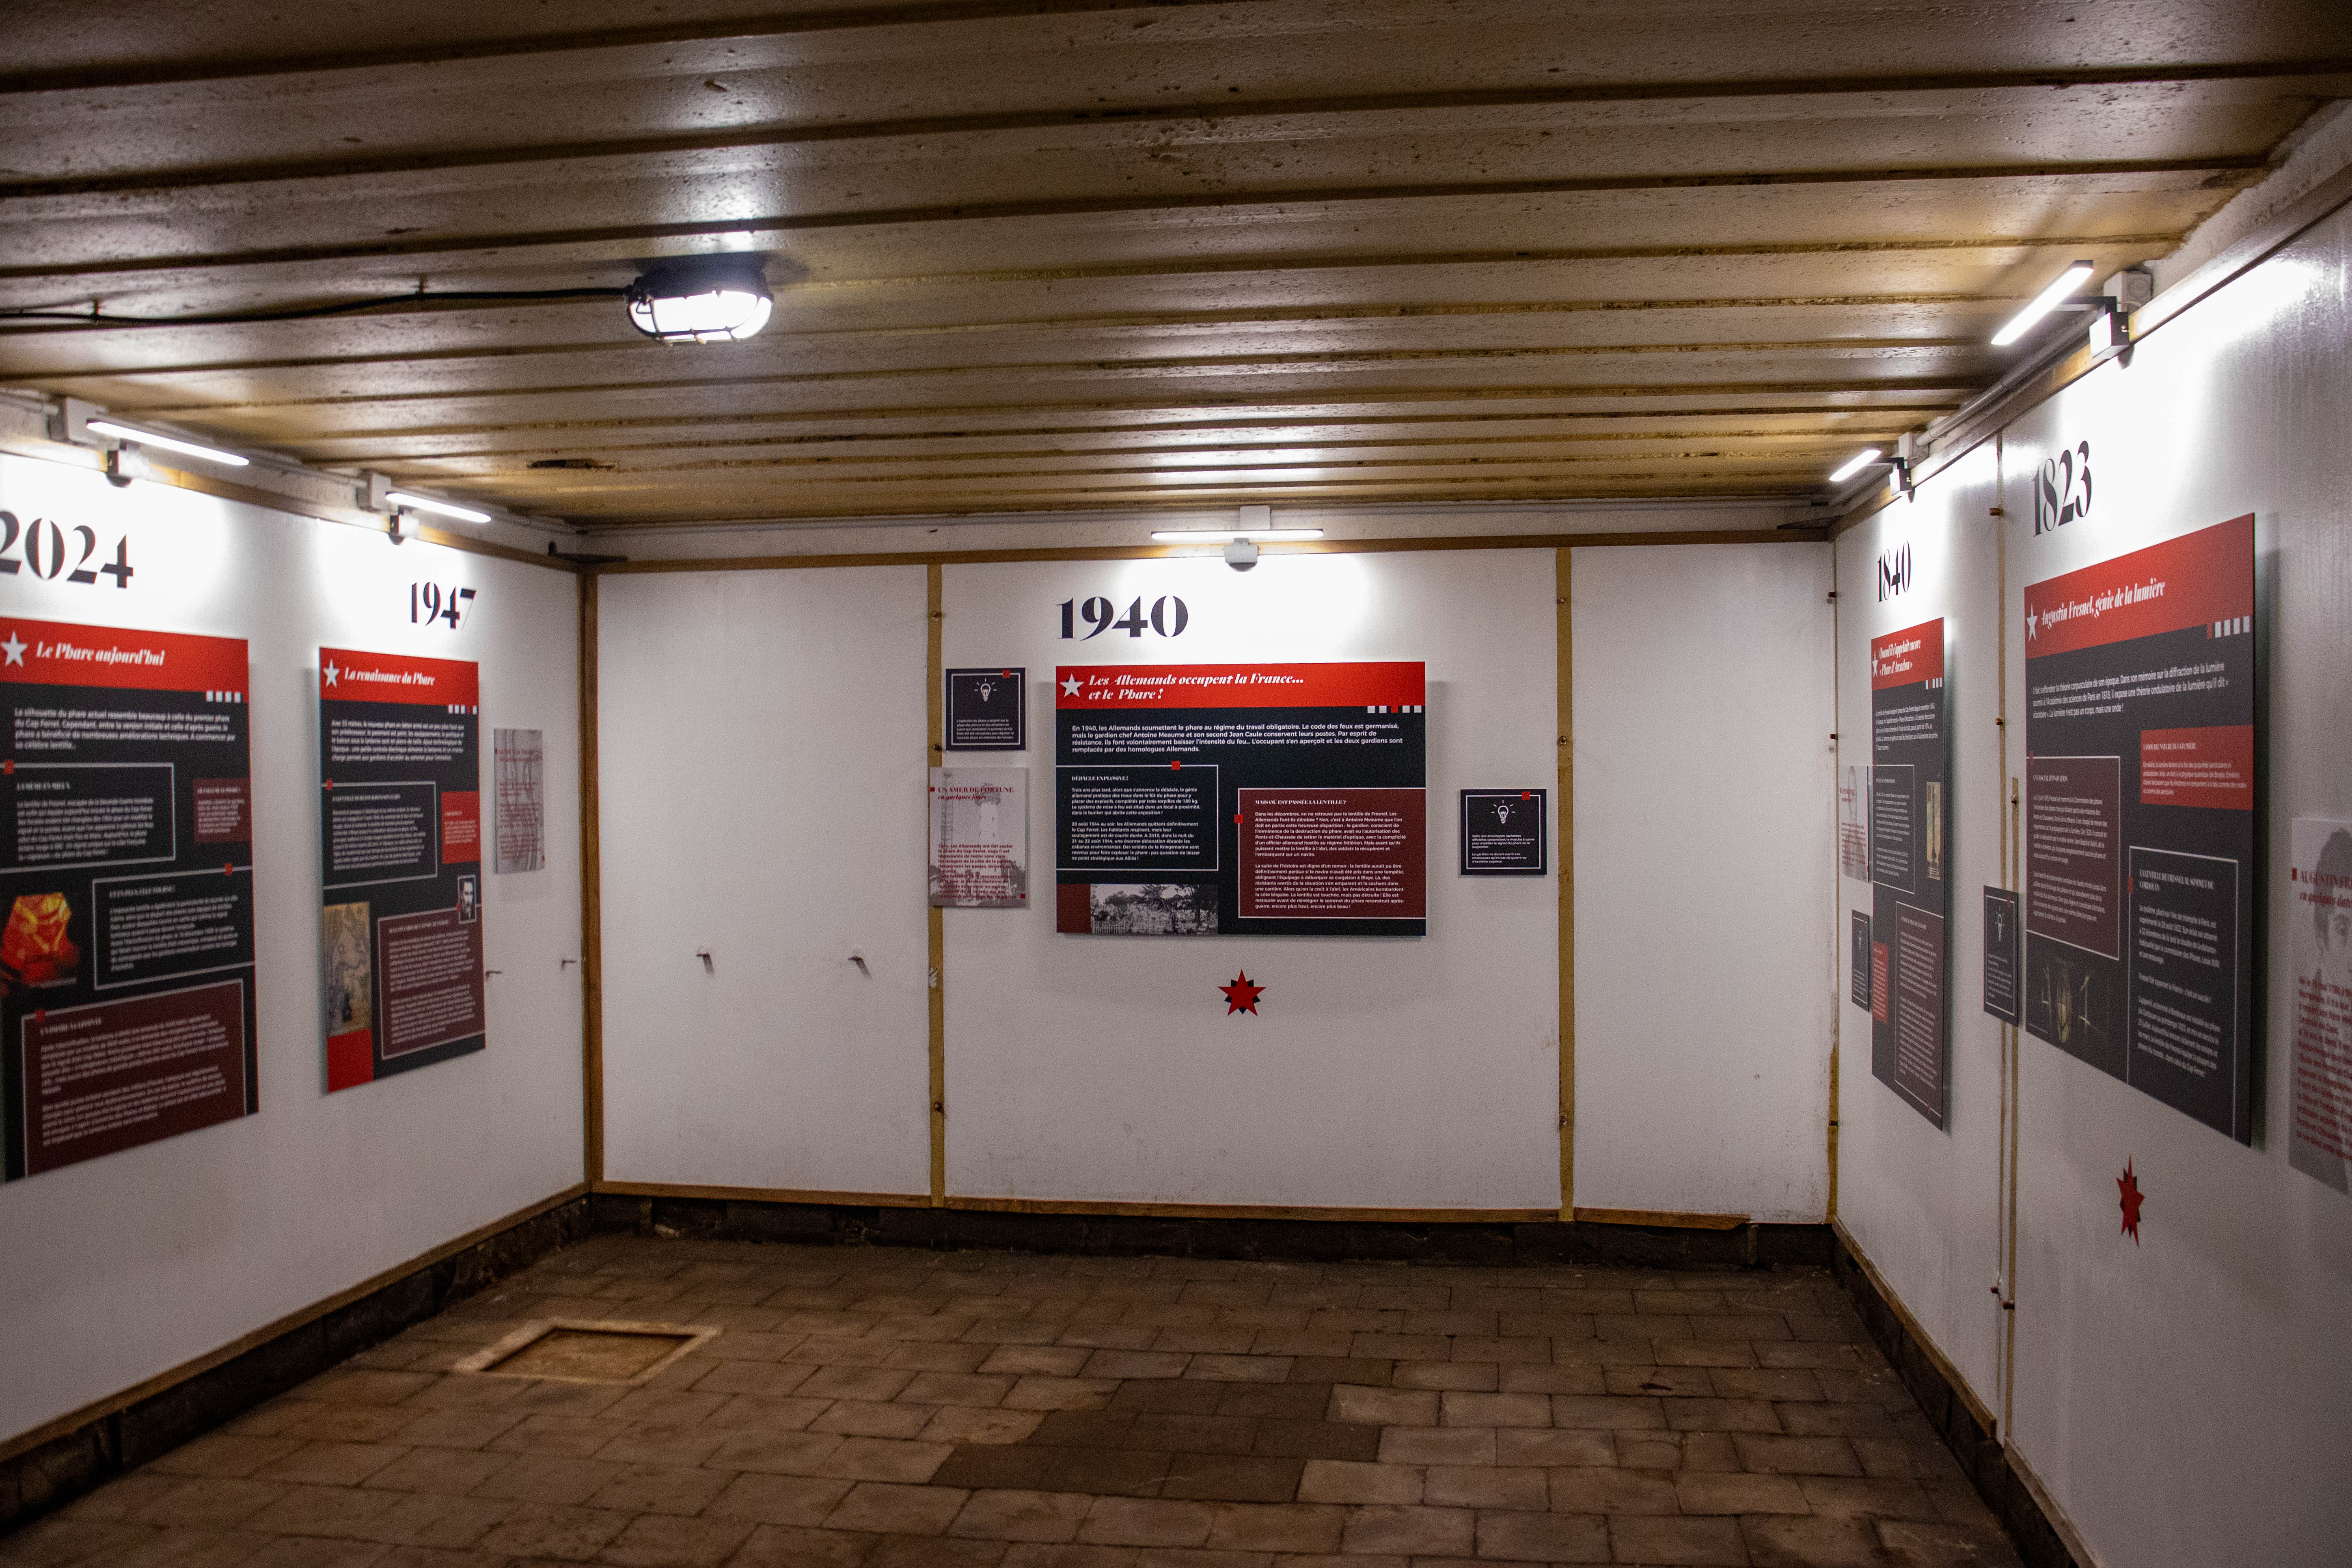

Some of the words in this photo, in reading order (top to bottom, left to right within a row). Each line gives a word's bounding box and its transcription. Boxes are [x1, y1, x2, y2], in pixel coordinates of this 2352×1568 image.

[2033, 440, 2092, 537] 1823
[0, 511, 134, 589] 2024
[1877, 540, 1912, 603] 1840
[410, 582, 477, 630] 1947
[1055, 595, 1188, 641] 1940
[2042, 602, 2067, 629] Augustin
[2068, 595, 2094, 619] Fresnel,
[2094, 589, 2114, 618] génie
[2114, 588, 2124, 608] de
[2124, 586, 2133, 605] la
[2134, 578, 2165, 603] lumière
[37, 641, 53, 658] Le
[56, 643, 94, 661] Phare
[95, 646, 165, 666] aujourd'hui
[345, 666, 356, 680] La
[357, 668, 401, 684] renaissance
[402, 671, 412, 684] du
[413, 672, 435, 686] Phare
[1089, 675, 1109, 686] Les
[1111, 674, 1177, 685] Allemands
[1178, 675, 1233, 687] occupent
[1234, 673, 1247, 684] la
[1089, 690, 1100, 700] et
[1103, 690, 1113, 700] le
[1118, 689, 1156, 700] Phare
